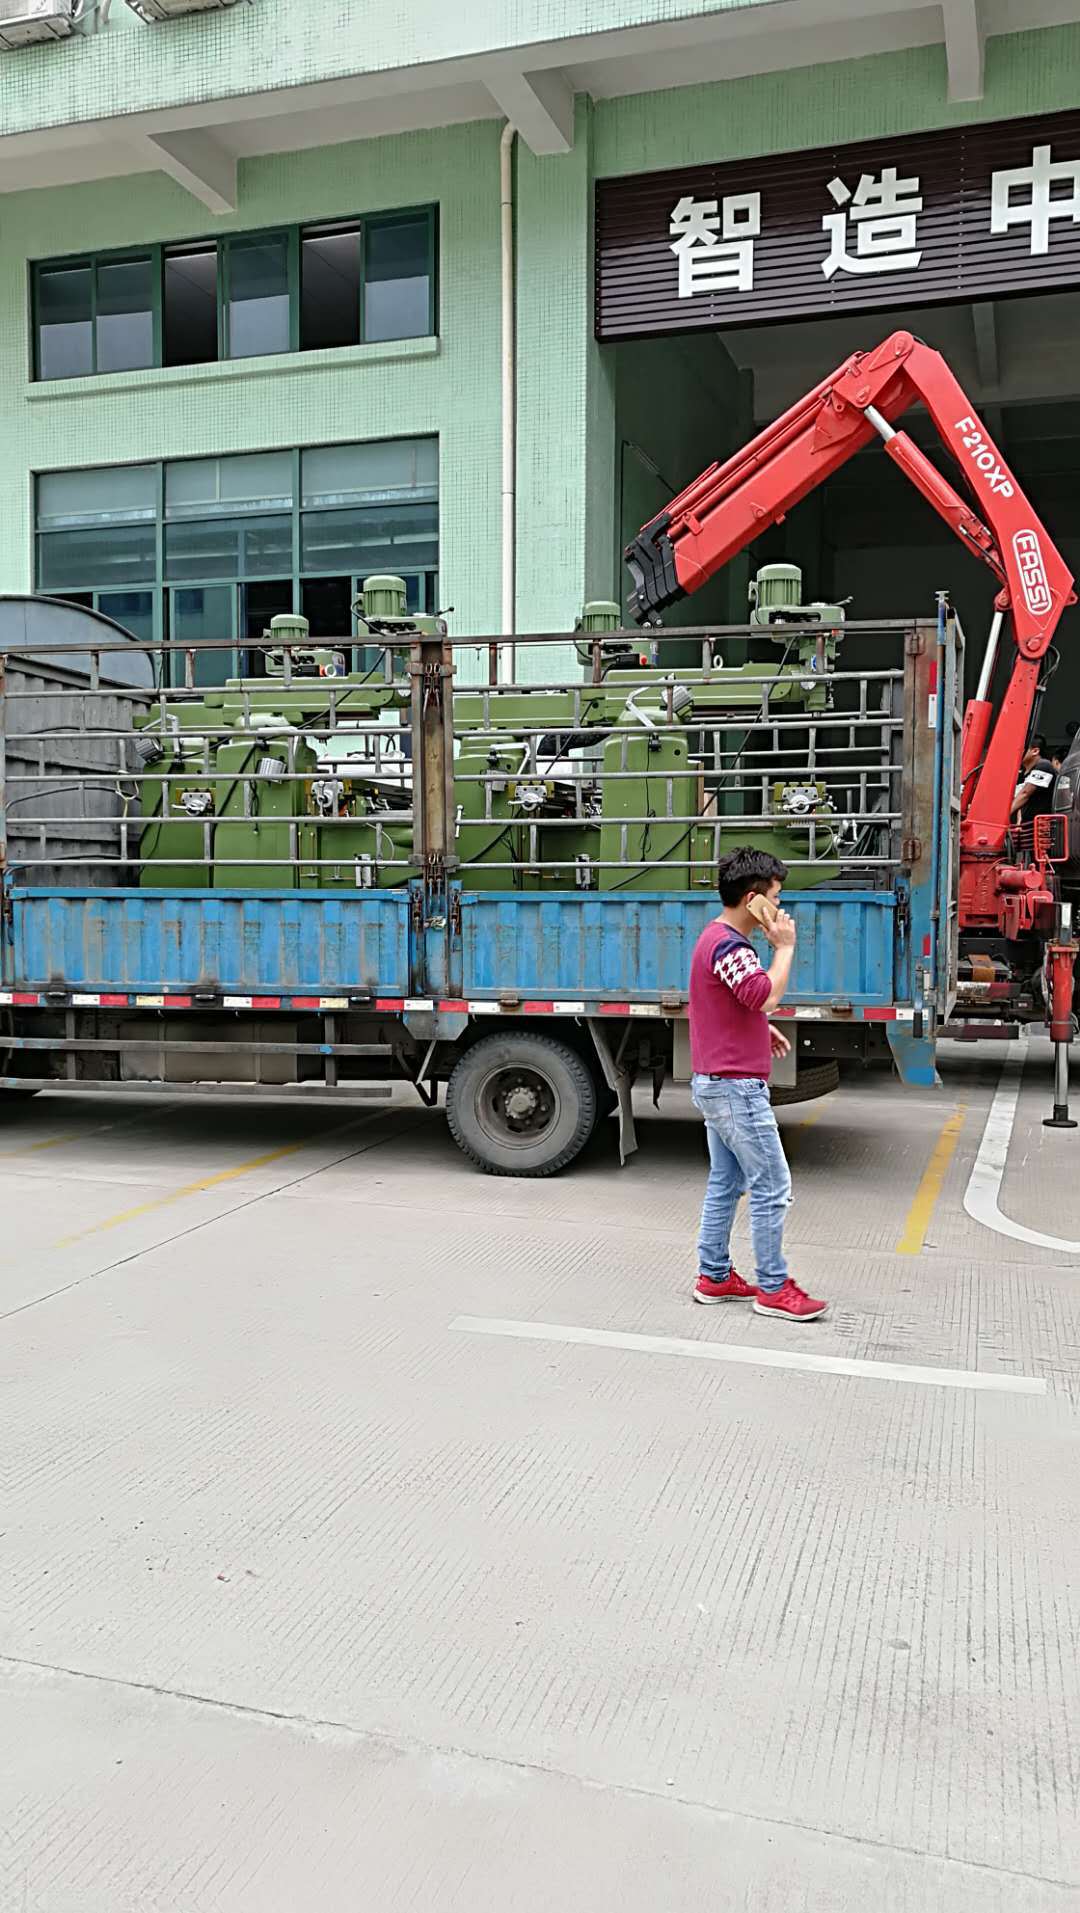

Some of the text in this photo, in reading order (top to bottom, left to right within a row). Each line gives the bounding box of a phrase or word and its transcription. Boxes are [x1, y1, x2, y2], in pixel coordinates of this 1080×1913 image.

[669, 144, 1080, 298] 智造中
[954, 416, 1014, 498] F210XP
[1017, 534, 1049, 610] FASSI
